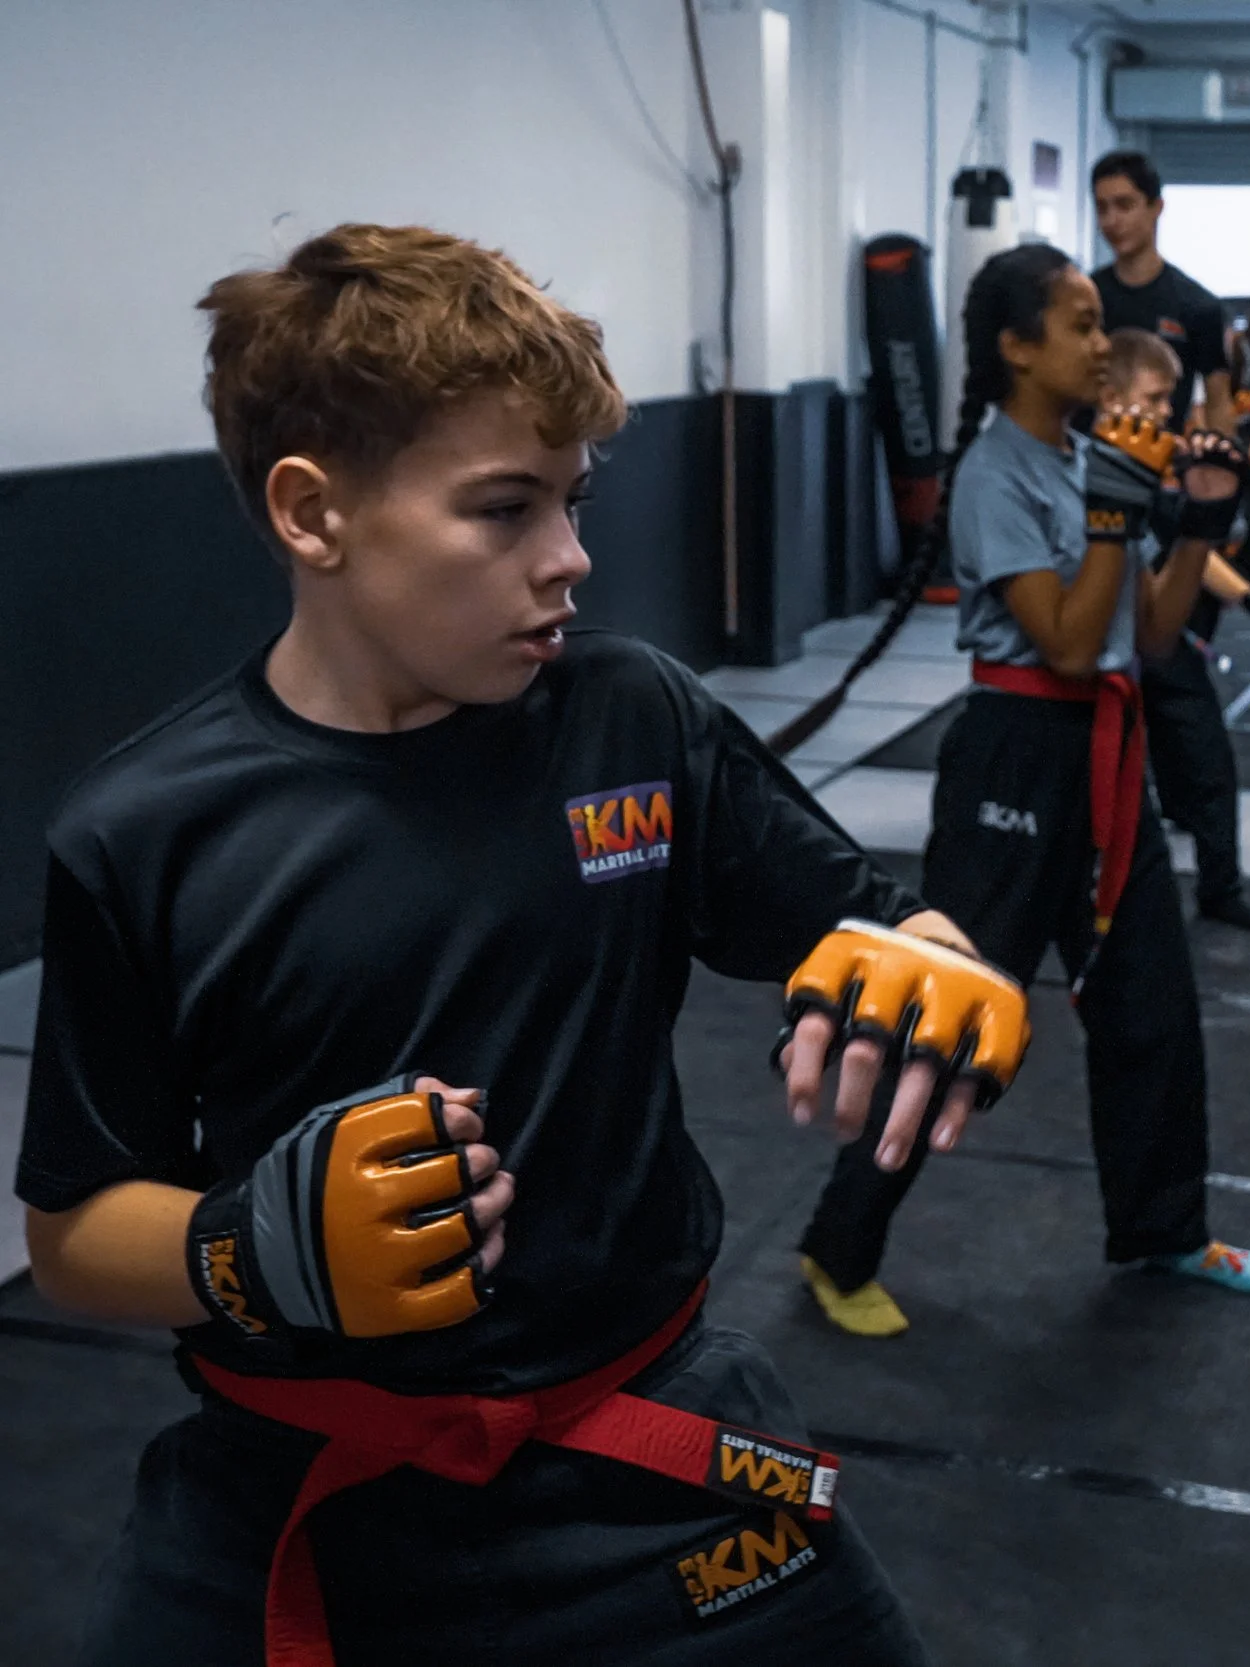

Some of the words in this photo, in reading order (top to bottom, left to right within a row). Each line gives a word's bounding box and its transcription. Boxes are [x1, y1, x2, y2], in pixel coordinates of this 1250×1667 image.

[581, 848, 645, 876] MARTIAL
[722, 1433, 755, 1450] ARTS
[756, 1444, 813, 1470] MARTIAL
[697, 1573, 777, 1617] MARTIAL
[779, 1547, 816, 1578] ARTS
